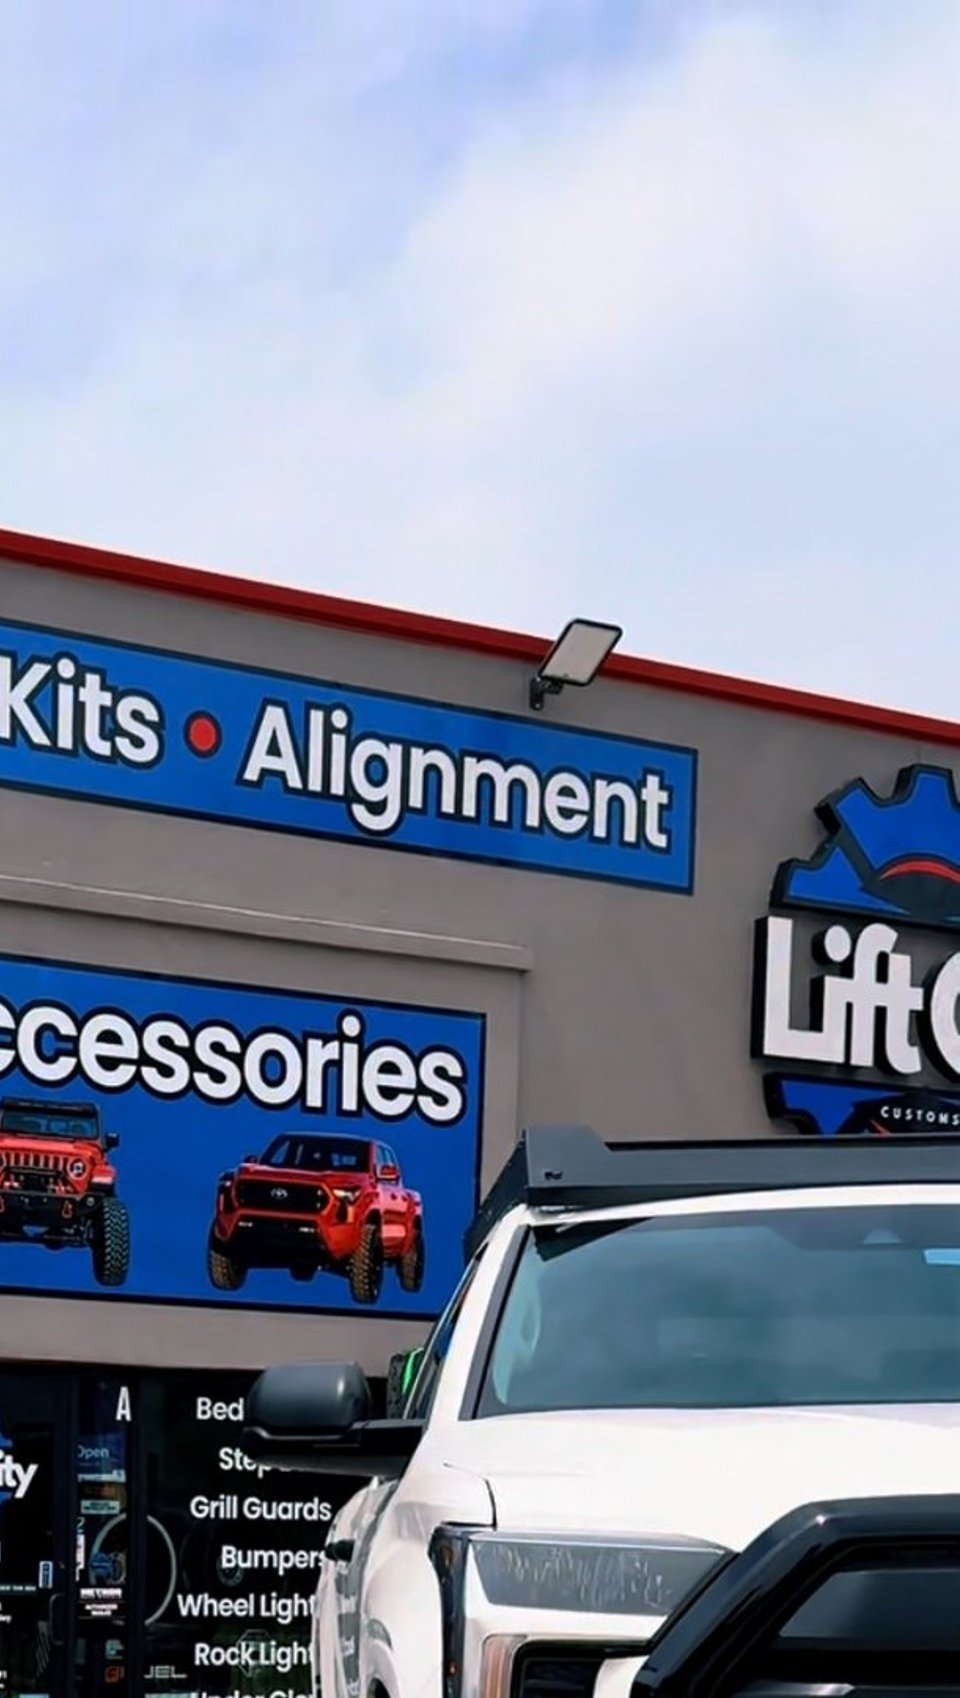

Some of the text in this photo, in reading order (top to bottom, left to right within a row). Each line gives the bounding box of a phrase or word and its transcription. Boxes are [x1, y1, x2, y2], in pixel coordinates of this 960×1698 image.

[242, 704, 669, 849] Alignment
[762, 915, 924, 1075] Lift
[880, 1105, 960, 1126] CUSTOMS
[115, 1385, 132, 1421] A
[196, 1397, 245, 1421] Bed
[189, 1493, 332, 1521] Grill Guards
[176, 1592, 255, 1617] Wheel
[194, 1641, 254, 1666] Rock
